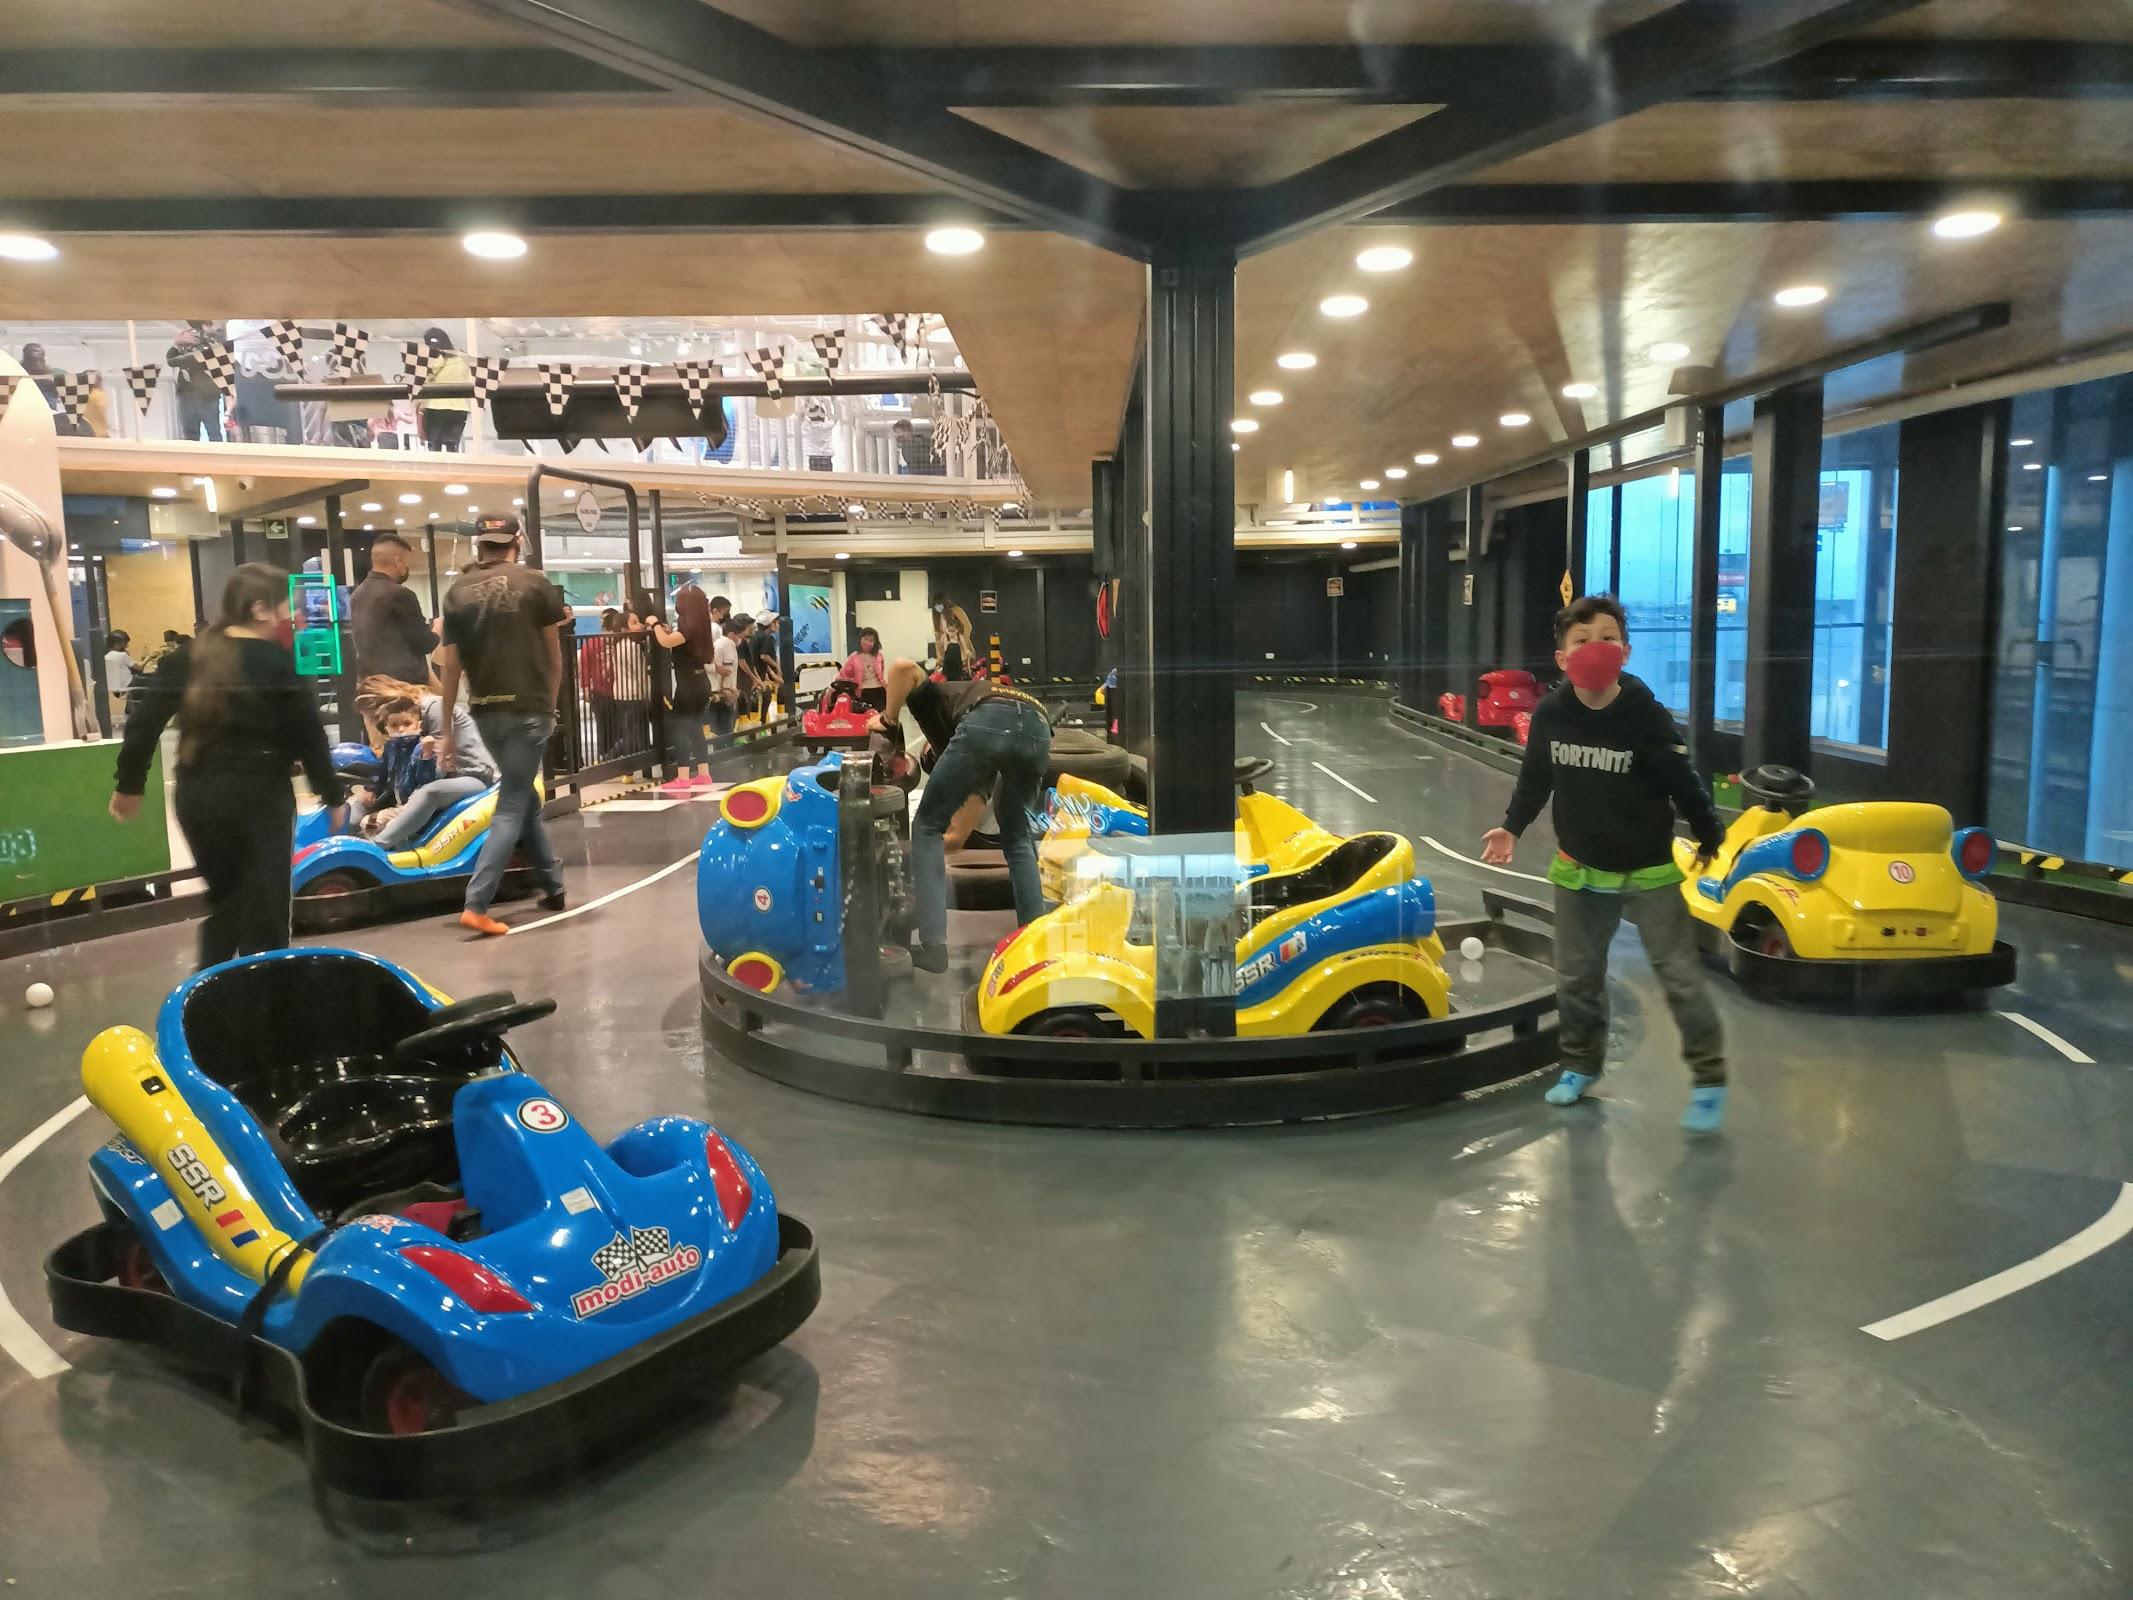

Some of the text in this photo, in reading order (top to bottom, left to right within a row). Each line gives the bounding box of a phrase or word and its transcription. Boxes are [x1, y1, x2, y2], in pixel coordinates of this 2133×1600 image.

[1549, 740, 1634, 774] FORTNITE
[1893, 864, 1912, 880] 10
[756, 895, 769, 906] 4
[531, 1104, 557, 1126] 3
[167, 1142, 227, 1211] SSR
[576, 1247, 701, 1315] modi-auto
